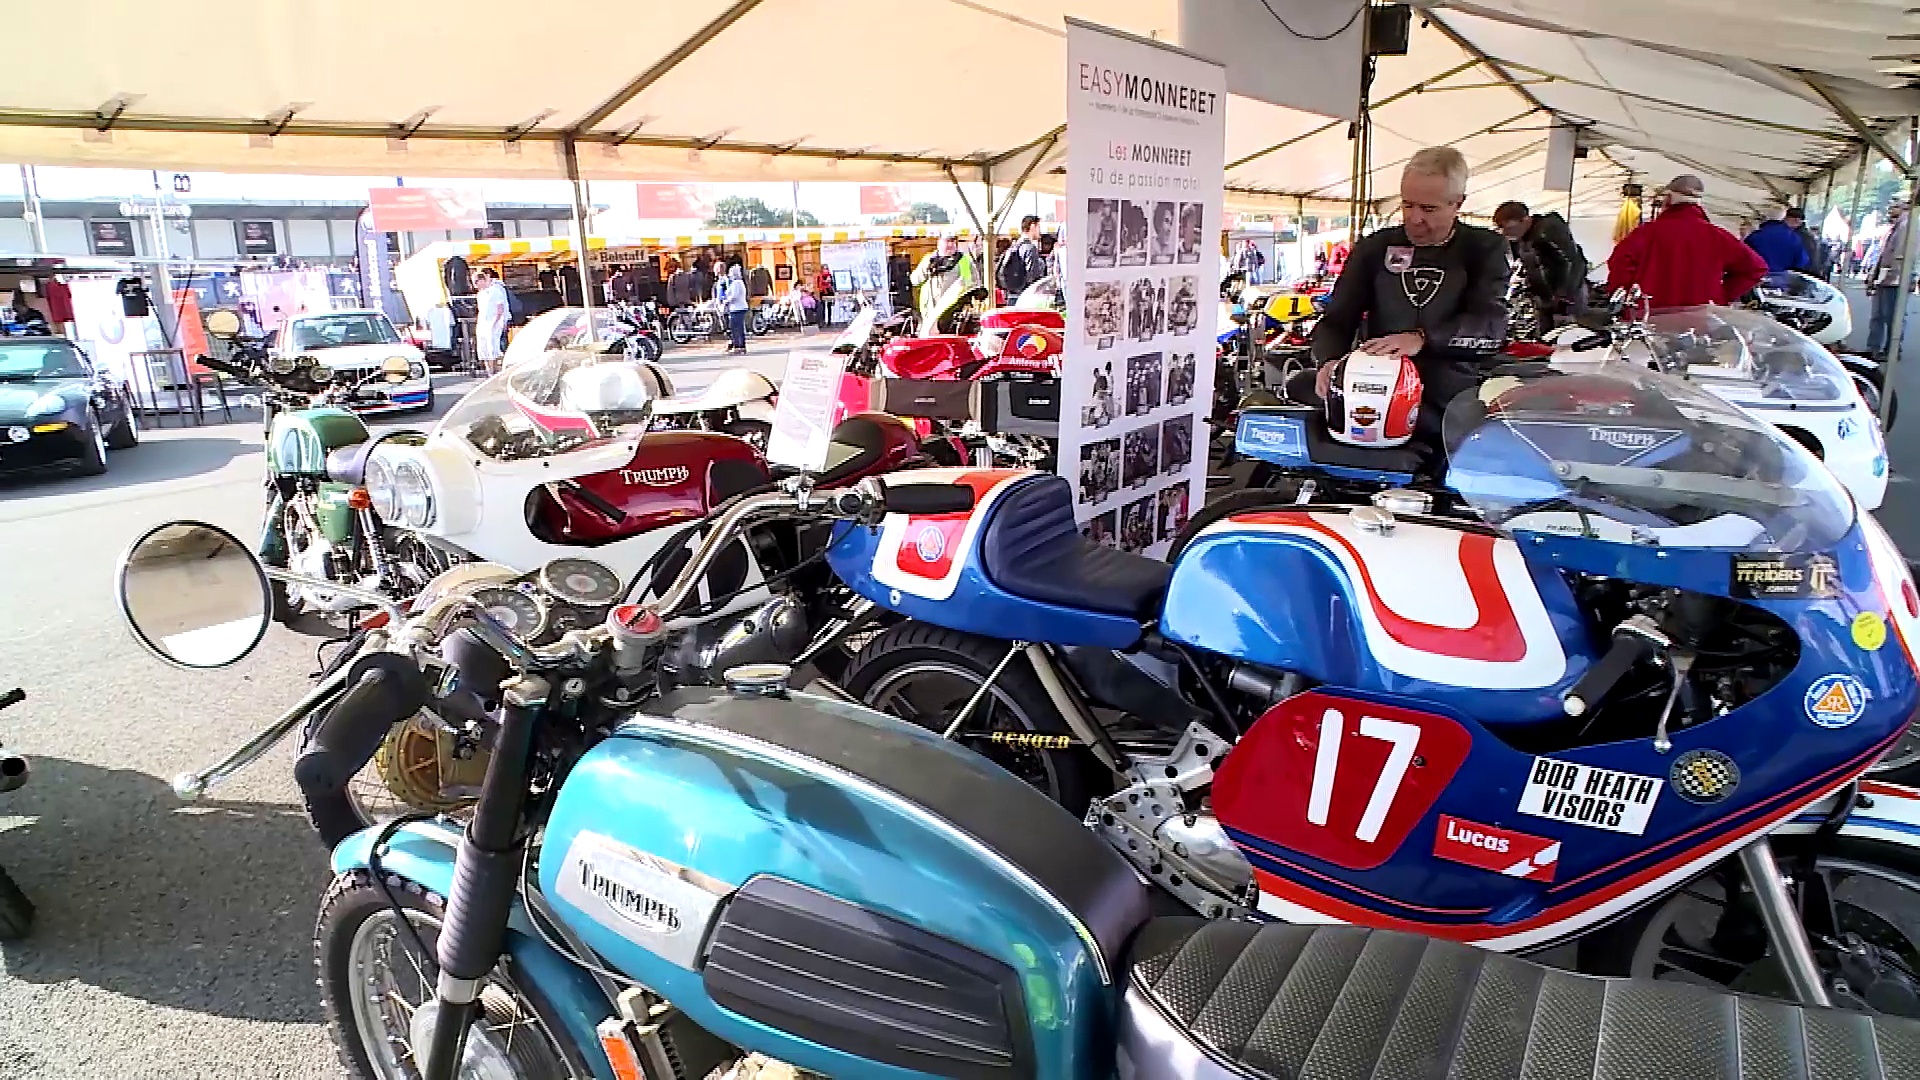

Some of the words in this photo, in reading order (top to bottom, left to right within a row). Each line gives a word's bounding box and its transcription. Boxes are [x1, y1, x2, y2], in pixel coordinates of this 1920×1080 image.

[1079, 63, 1217, 116] EASYMONNERET
[1108, 140, 1127, 161] Les
[1131, 143, 1192, 167] MONNERET
[1090, 167, 1104, 184] 90
[1109, 169, 1124, 185] de
[1287, 297, 1301, 316] 1
[1587, 428, 1657, 450] TRIUMPH
[619, 465, 690, 486] TRIUMPH
[991, 731, 1071, 749] RENOLD
[1307, 708, 1421, 844] 17
[1532, 759, 1580, 791] BOB
[1583, 769, 1655, 805] HEATH
[1541, 789, 1626, 827] VISORS
[1446, 820, 1511, 853] Lucas
[577, 858, 684, 936] TRIUMPH
